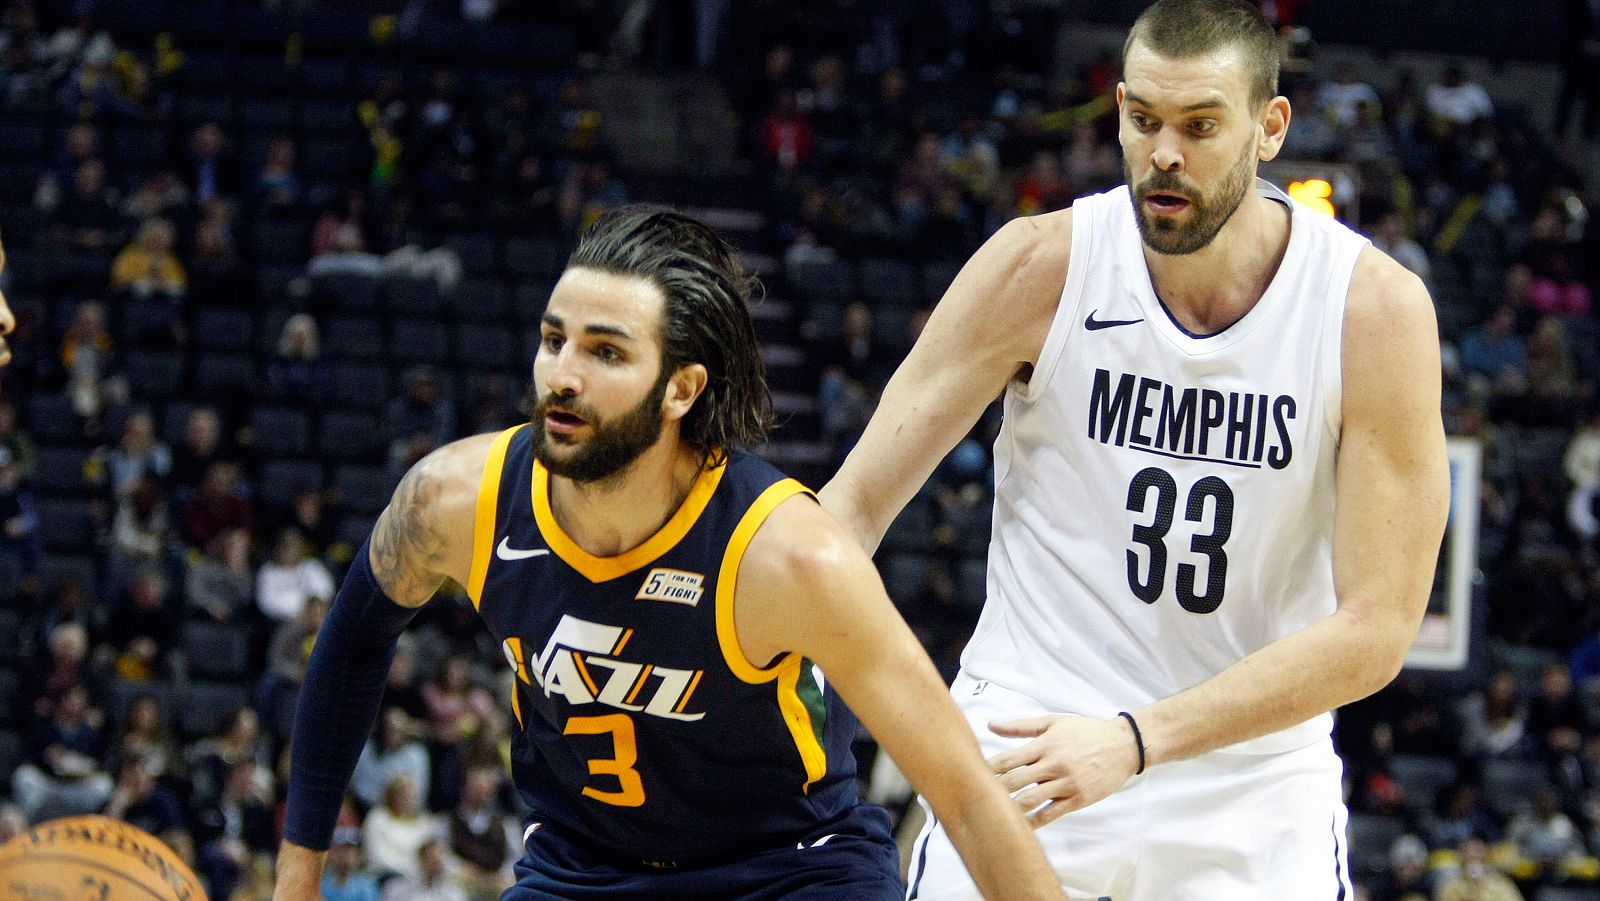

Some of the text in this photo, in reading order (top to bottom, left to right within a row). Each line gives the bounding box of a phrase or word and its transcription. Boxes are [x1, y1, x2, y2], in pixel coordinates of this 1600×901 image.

[1088, 368, 1297, 470] MEMPHIS
[644, 573, 666, 595] 5
[672, 574, 698, 585] FOR THE
[1126, 466, 1235, 615] 33
[663, 586, 699, 601] FIGHT
[531, 613, 707, 722] JAZZ
[562, 712, 647, 808] 3
